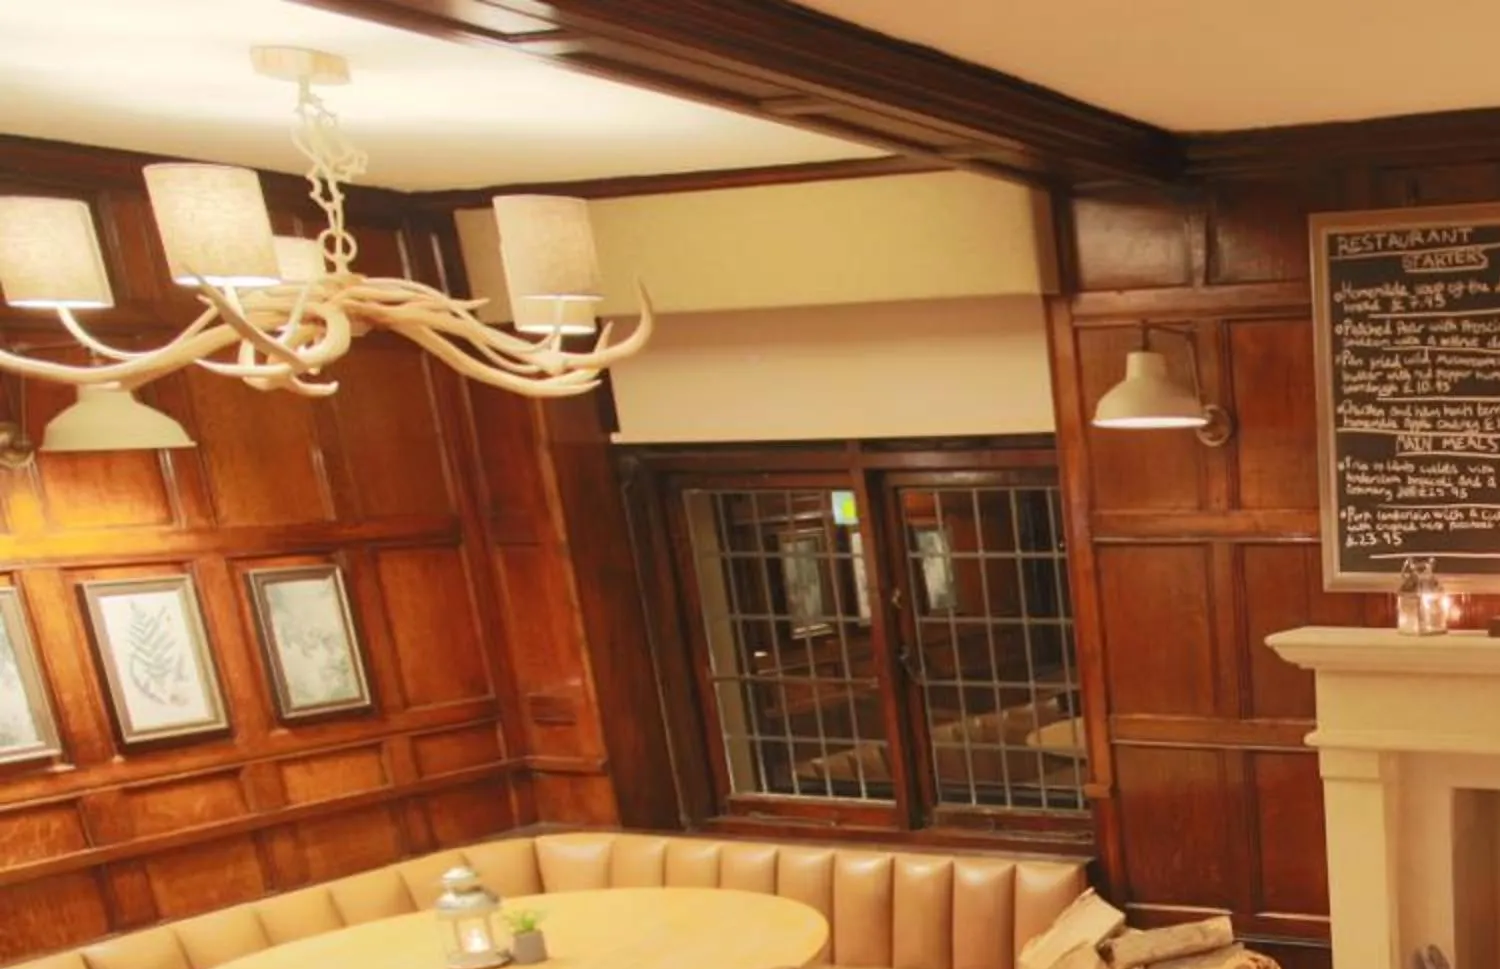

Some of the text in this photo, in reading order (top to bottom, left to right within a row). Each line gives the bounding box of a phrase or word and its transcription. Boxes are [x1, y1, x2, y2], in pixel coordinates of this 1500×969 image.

[1336, 229, 1473, 257] RESTAURANT
[1402, 249, 1489, 270] STARTERS
[1442, 435, 1500, 452] MEALS
